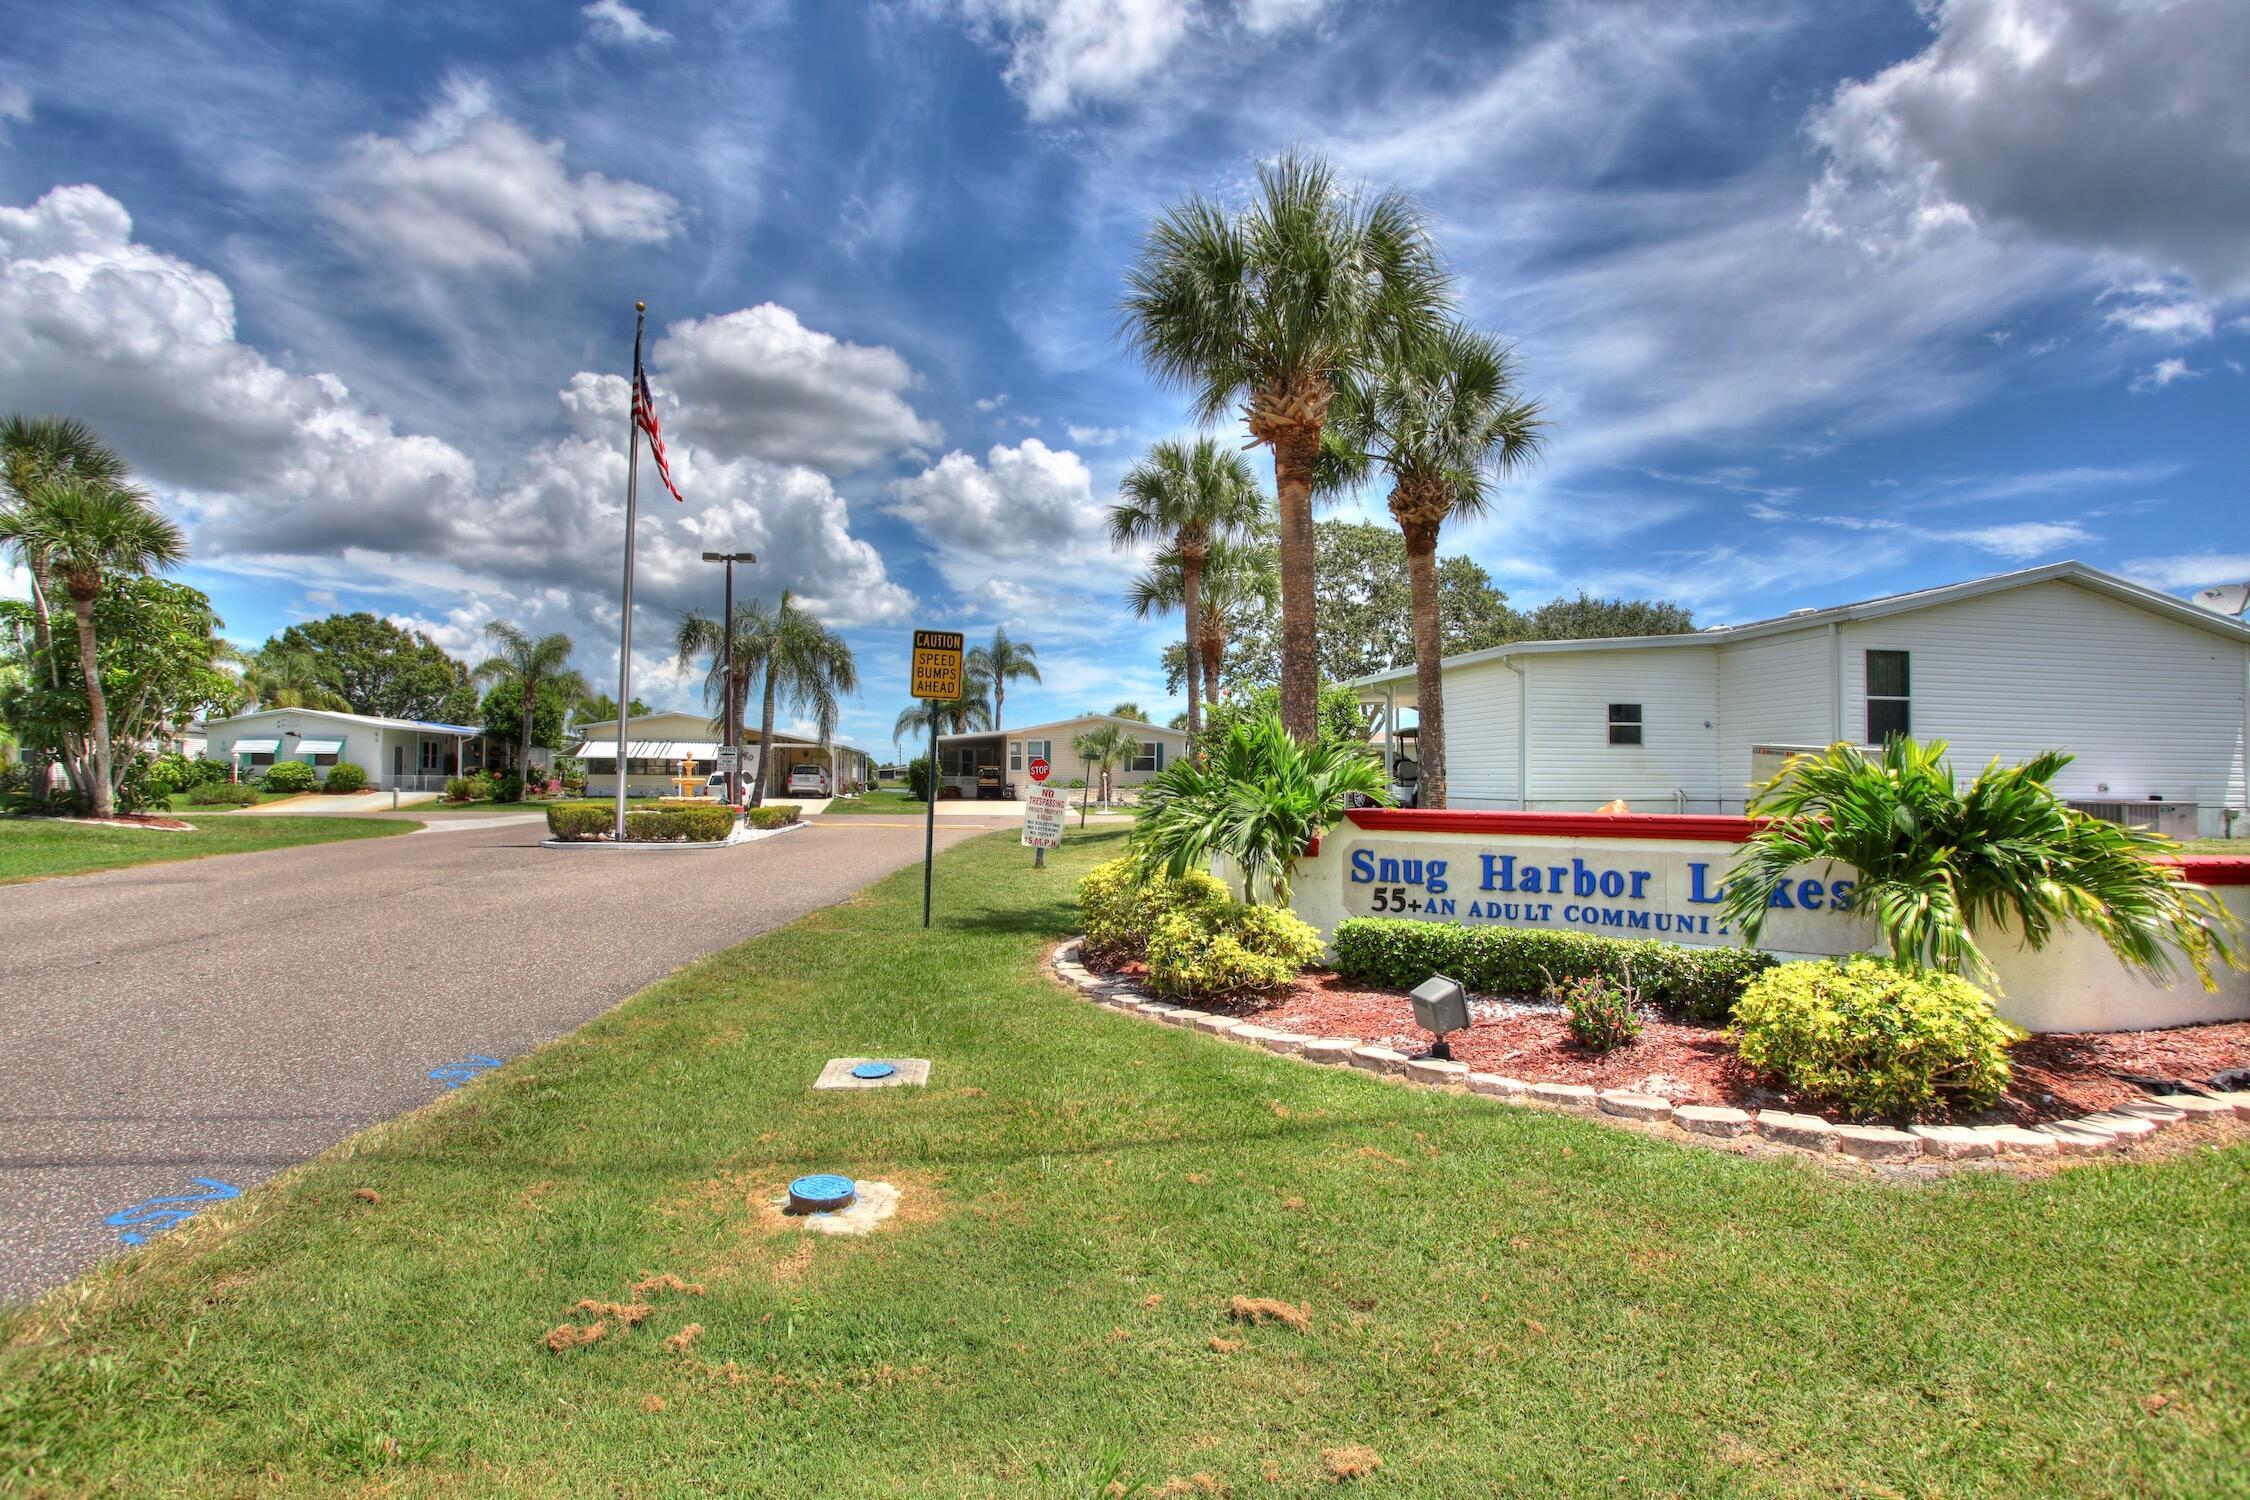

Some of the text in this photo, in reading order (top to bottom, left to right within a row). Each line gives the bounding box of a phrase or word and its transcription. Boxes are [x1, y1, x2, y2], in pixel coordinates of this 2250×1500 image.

[917, 634, 960, 648] CAUTION
[919, 653, 955, 666] SPEED
[917, 667, 956, 680] BUMPS
[917, 681, 955, 693] AHEAD
[1030, 765, 1049, 775] STOP
[1041, 789, 1054, 798] NO
[1029, 796, 1065, 808] TRESPASSING
[1028, 806, 1043, 814] PRIVATE
[1024, 836, 1032, 844] 15
[1351, 849, 1856, 911] Snug Harbor Lkes
[1423, 898, 1456, 915] AN
[1468, 901, 1553, 921] ADULT
[1563, 905, 1755, 938] COMMUNI
